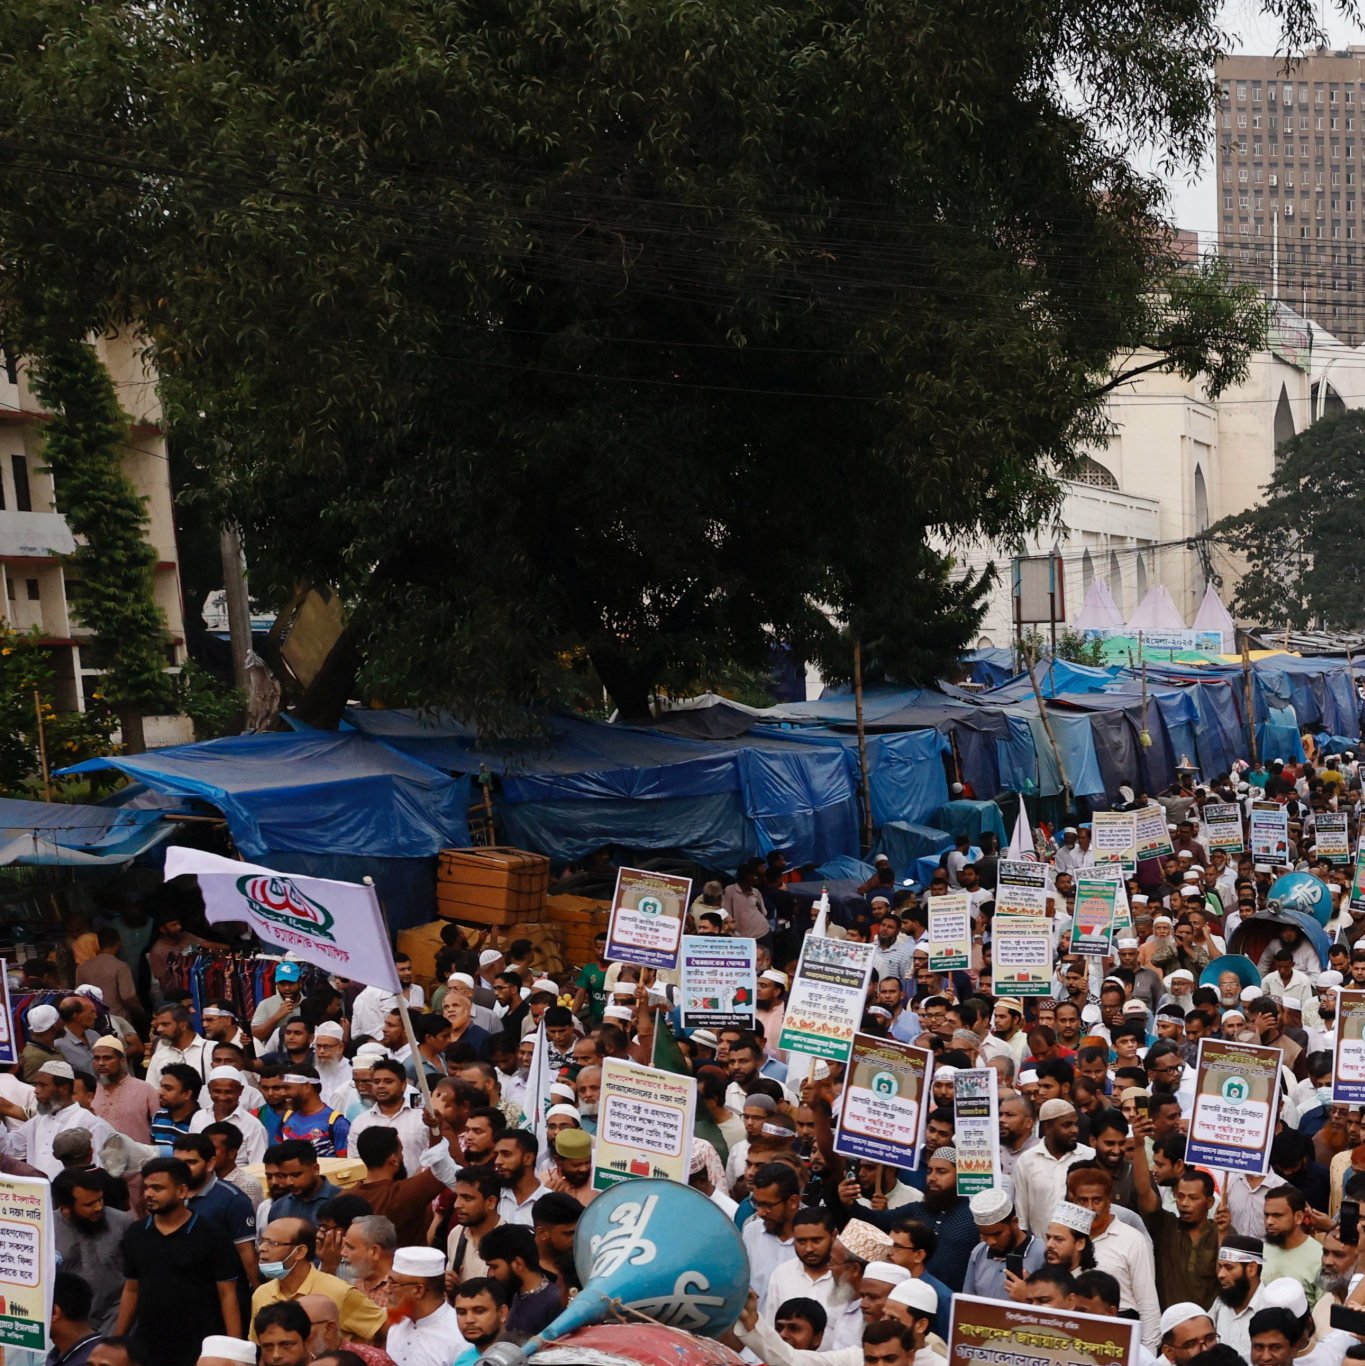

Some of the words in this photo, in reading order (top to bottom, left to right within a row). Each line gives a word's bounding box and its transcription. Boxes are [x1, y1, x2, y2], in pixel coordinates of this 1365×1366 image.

[959, 1323, 1011, 1337] বাংলাদেশ
[1015, 1332, 1068, 1348] জামায়াতে
[1072, 1337, 1124, 1357] ইসলামীর
